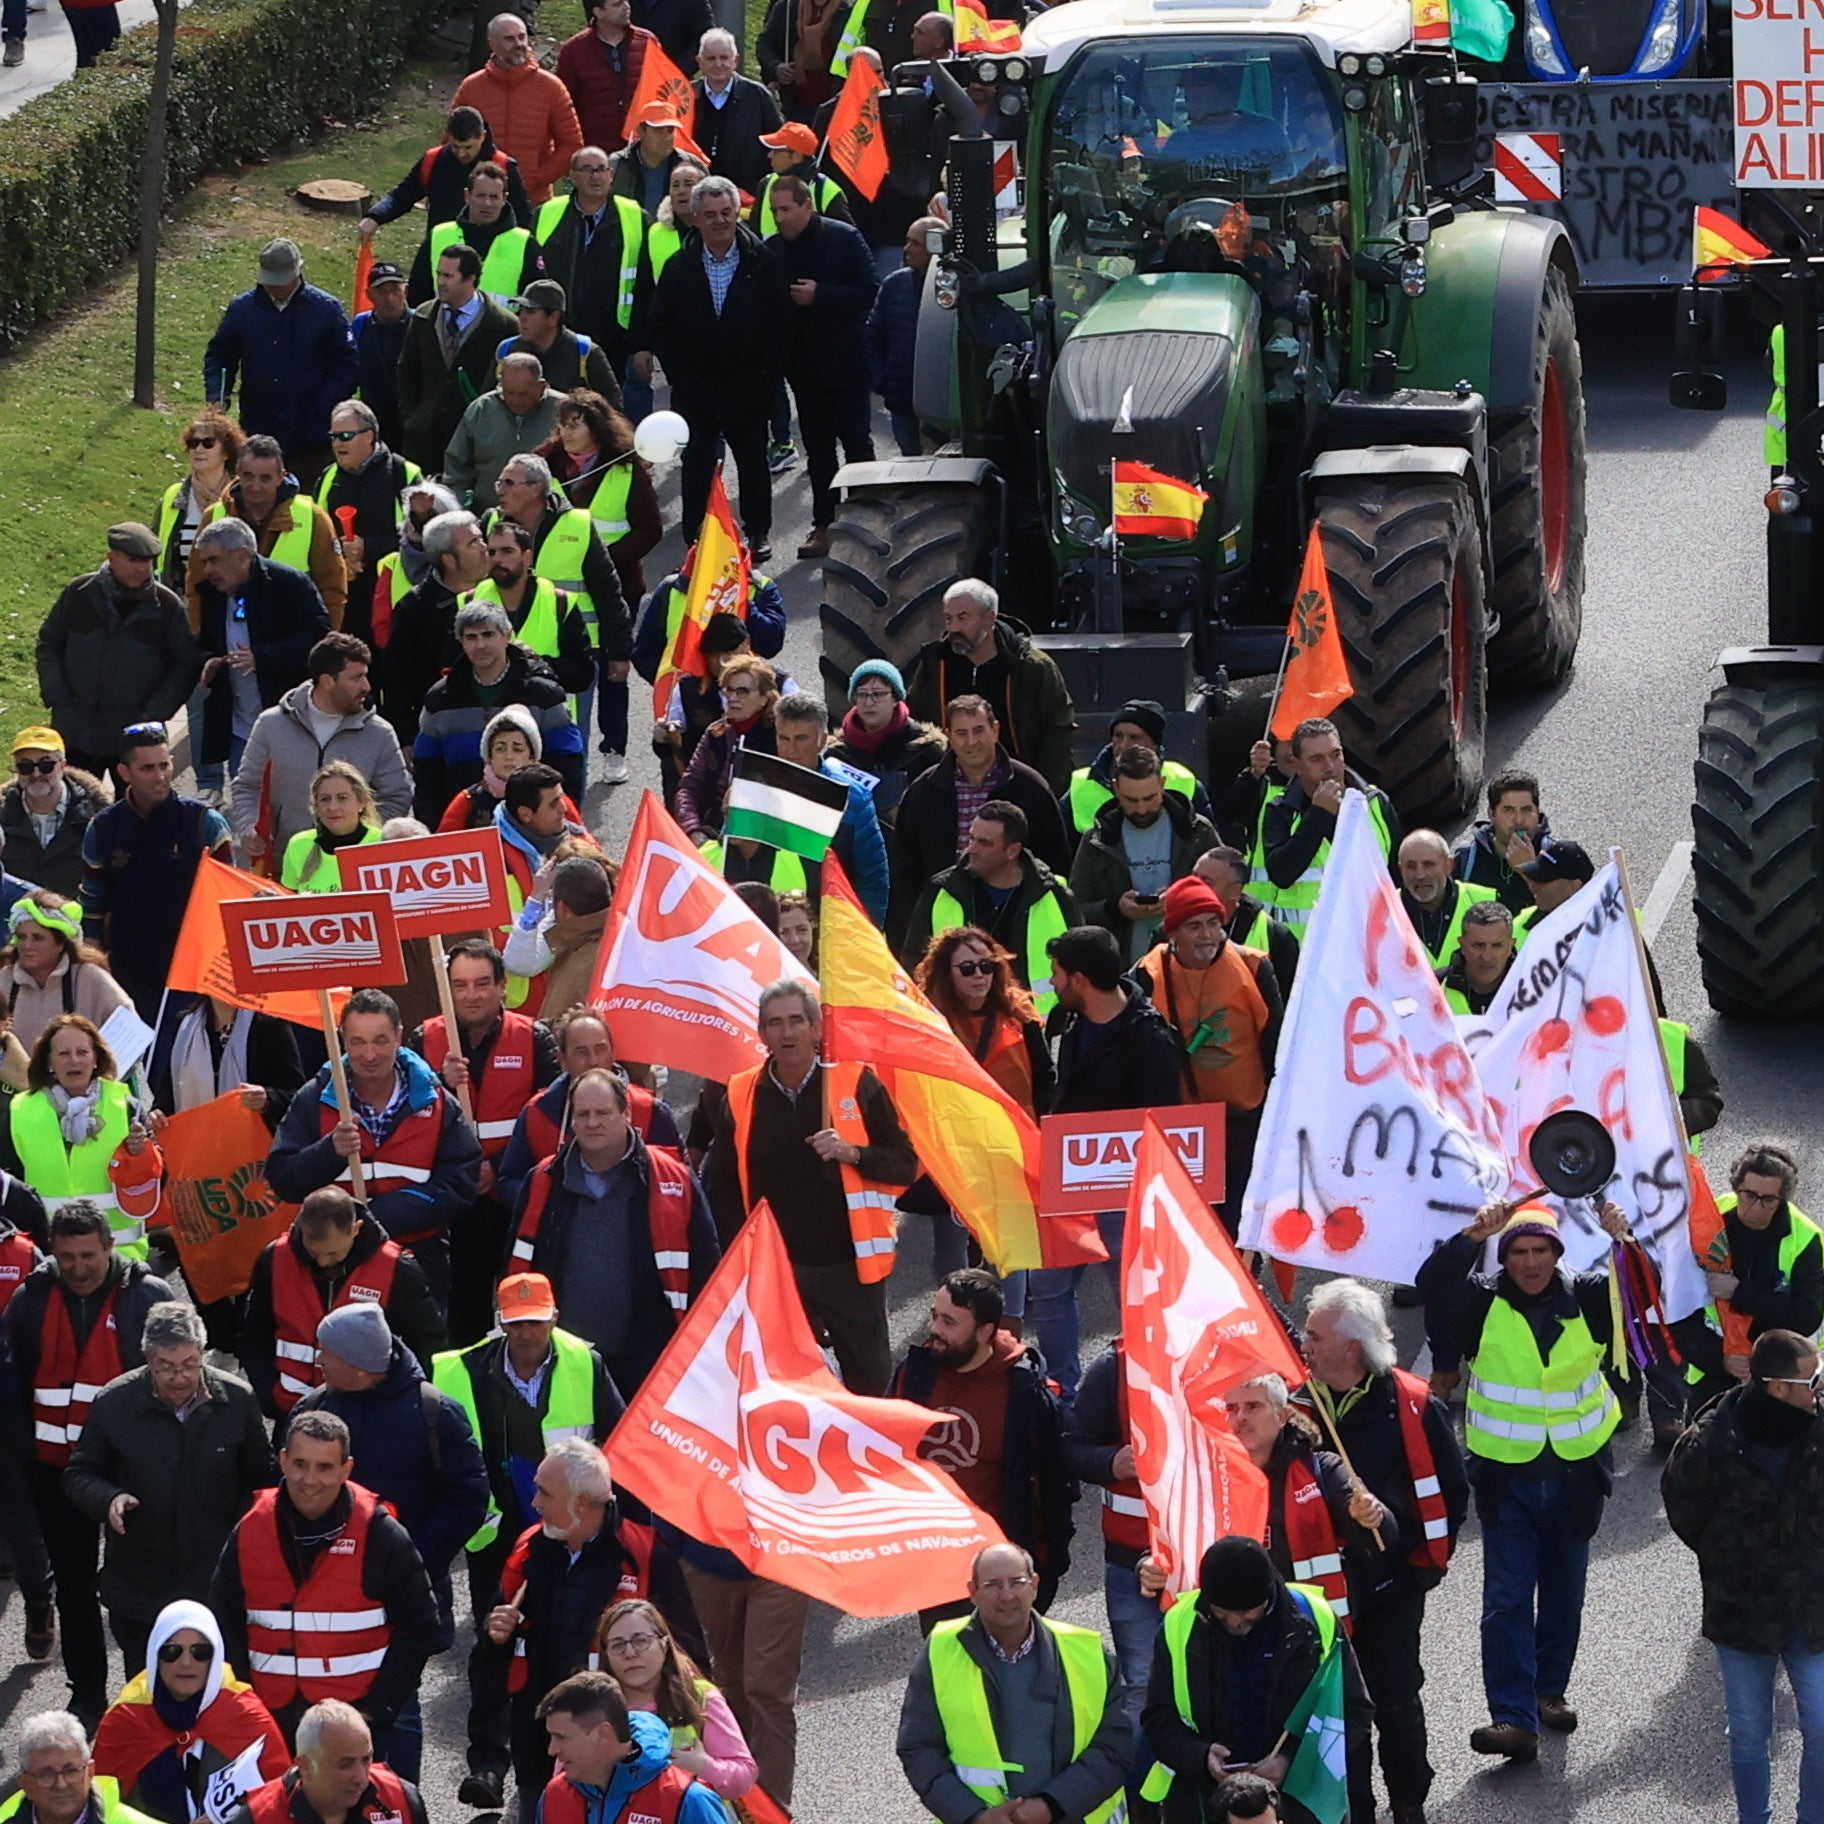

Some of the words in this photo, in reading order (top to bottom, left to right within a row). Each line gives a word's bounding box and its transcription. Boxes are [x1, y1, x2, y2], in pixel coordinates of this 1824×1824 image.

[360, 853, 484, 895] UAGN
[248, 916, 374, 951] UAGN
[623, 997, 642, 1012] DE
[642, 997, 739, 1036] AGRICULTORES
[742, 1033, 753, 1045] Y
[1067, 1131, 1200, 1167] UAN
[352, 1286, 379, 1299] UAGN
[649, 1419, 708, 1464] UNIÓN
[707, 1457, 731, 1479] DE
[878, 1542, 903, 1557] DE
[905, 1533, 986, 1550] NAVARRA
